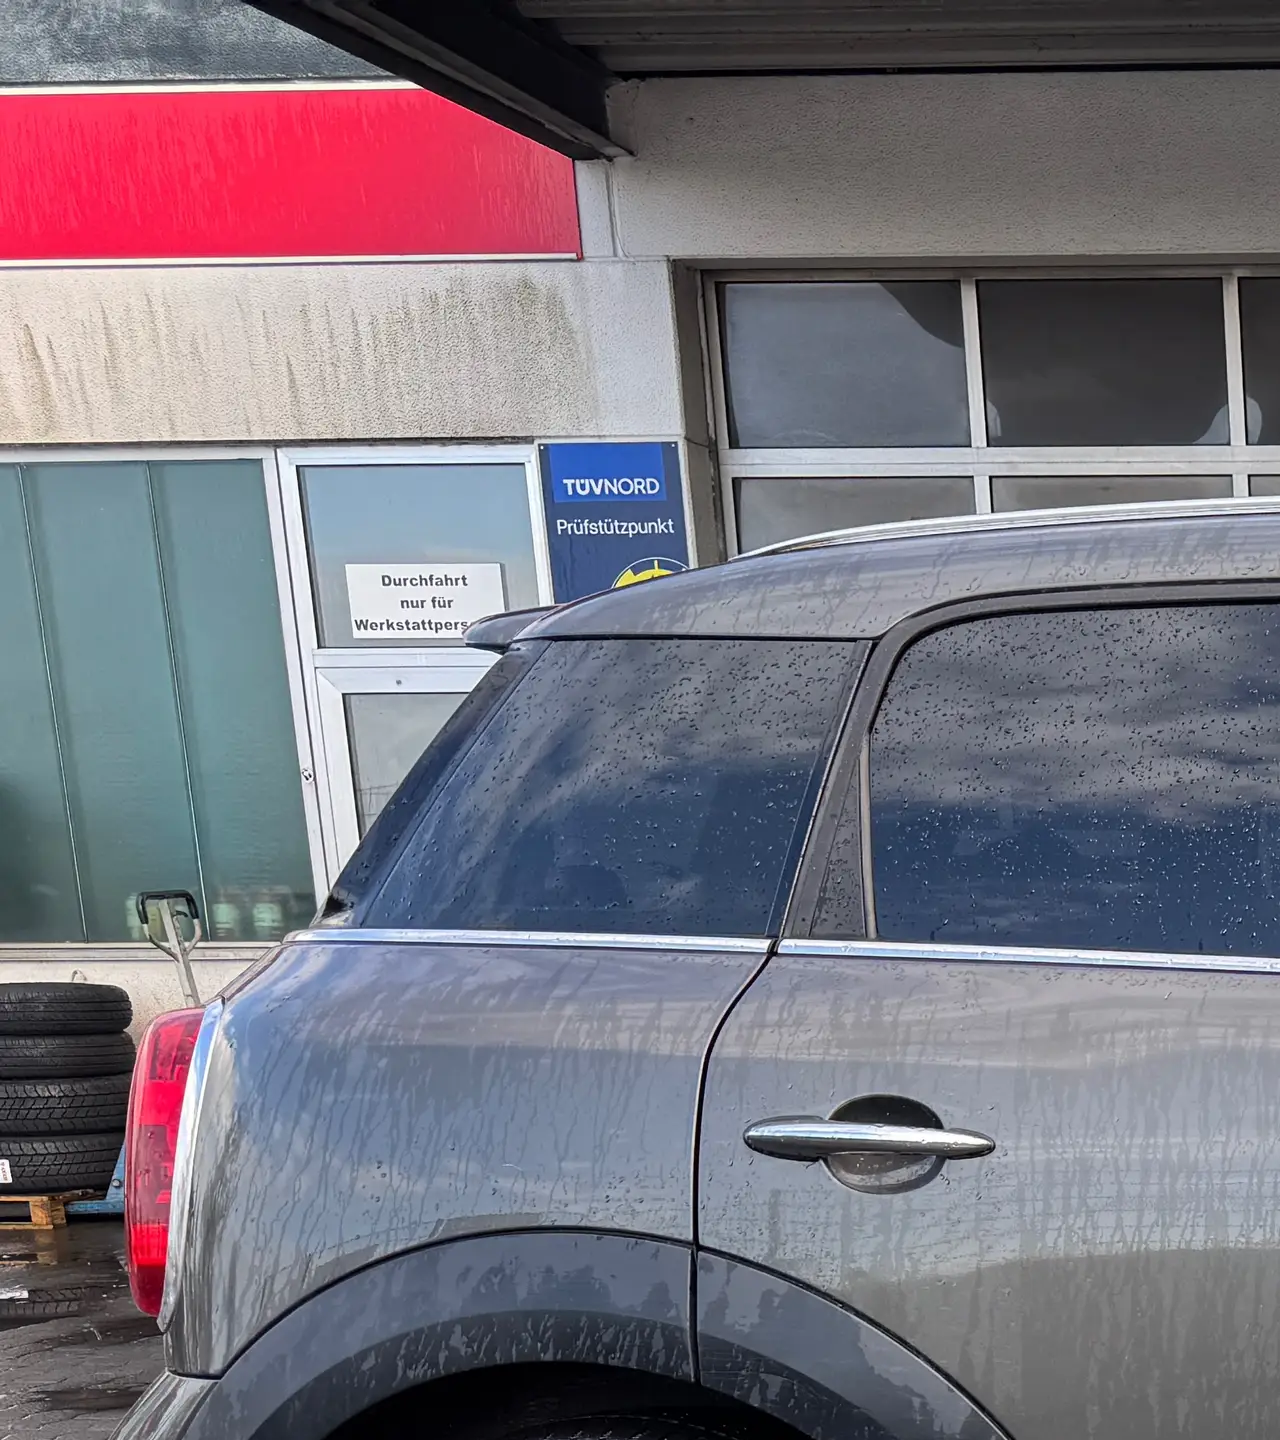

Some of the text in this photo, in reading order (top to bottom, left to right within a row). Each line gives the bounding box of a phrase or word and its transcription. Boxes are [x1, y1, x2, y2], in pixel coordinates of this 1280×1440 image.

[556, 518, 675, 538] Prüfstützpunkt
[381, 574, 468, 587] Durchfahrt
[400, 596, 454, 609] nur für
[354, 619, 468, 634] Werkstattpers
